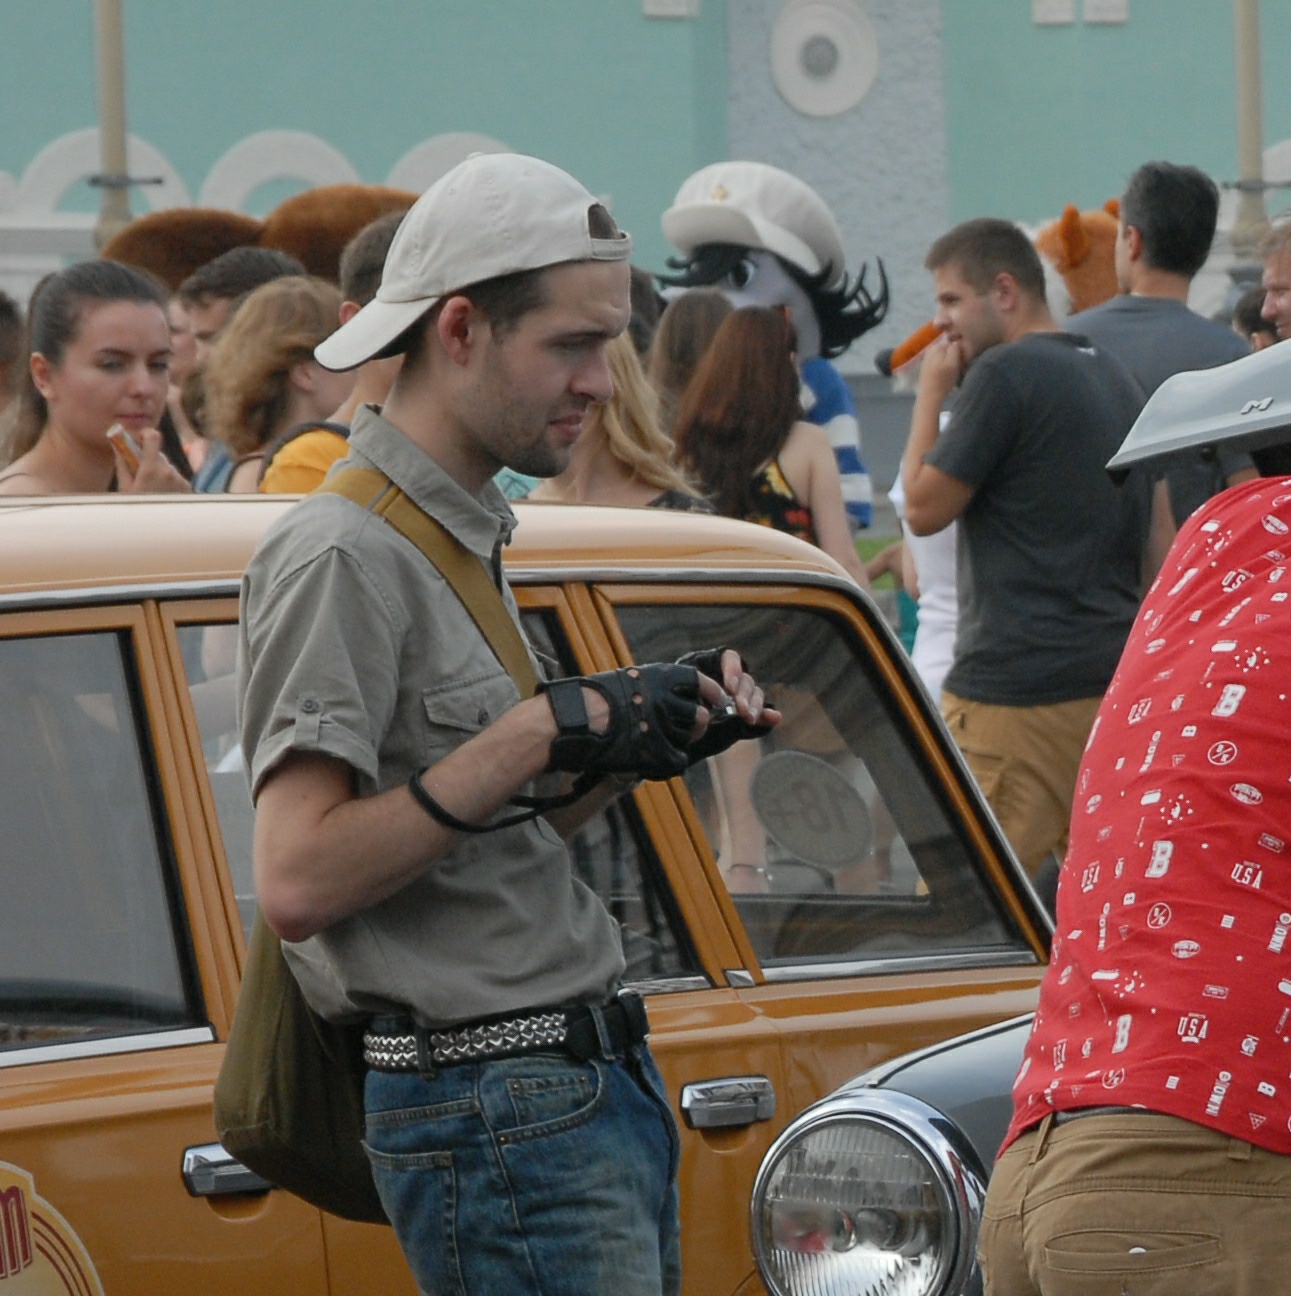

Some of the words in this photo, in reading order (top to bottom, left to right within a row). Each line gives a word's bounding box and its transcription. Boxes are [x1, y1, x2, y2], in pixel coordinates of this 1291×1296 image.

[1211, 684, 1246, 717] B
[1145, 840, 1174, 878] B
[1231, 862, 1263, 889] USA
[1112, 1014, 1132, 1054] B
[1178, 1016, 1209, 1039] USA
